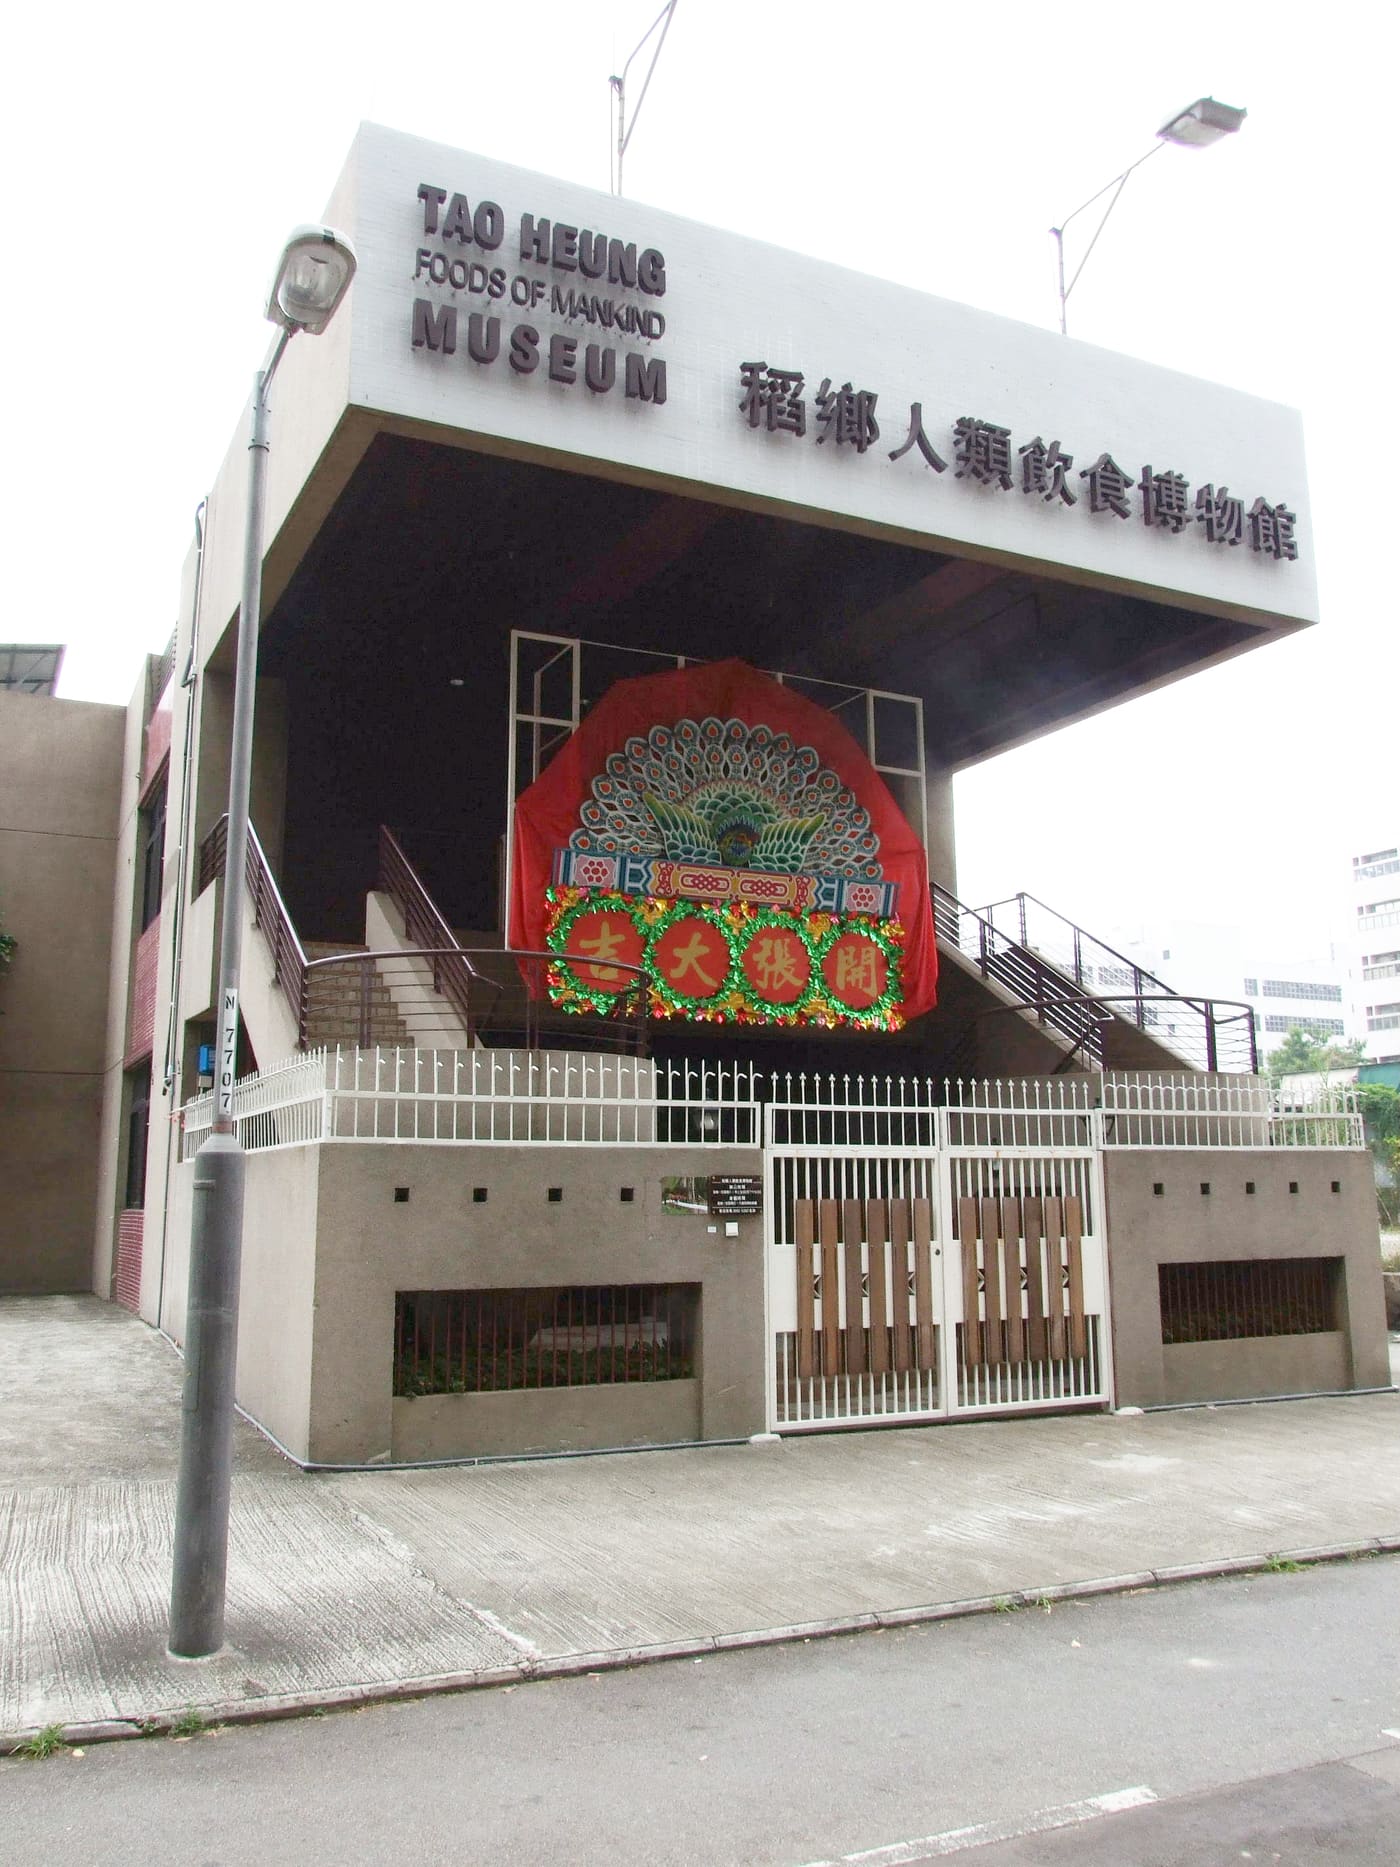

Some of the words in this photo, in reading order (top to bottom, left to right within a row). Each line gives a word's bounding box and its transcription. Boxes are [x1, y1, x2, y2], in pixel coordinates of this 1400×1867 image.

[417, 183, 504, 251] TAO
[519, 212, 666, 297] HEUNG
[415, 248, 506, 298] FOODS
[511, 275, 546, 308] OF
[551, 285, 666, 340] MANKIND
[412, 298, 667, 405] MUSEUM
[225, 995, 235, 1010] N
[221, 1028, 235, 1109] 7707
